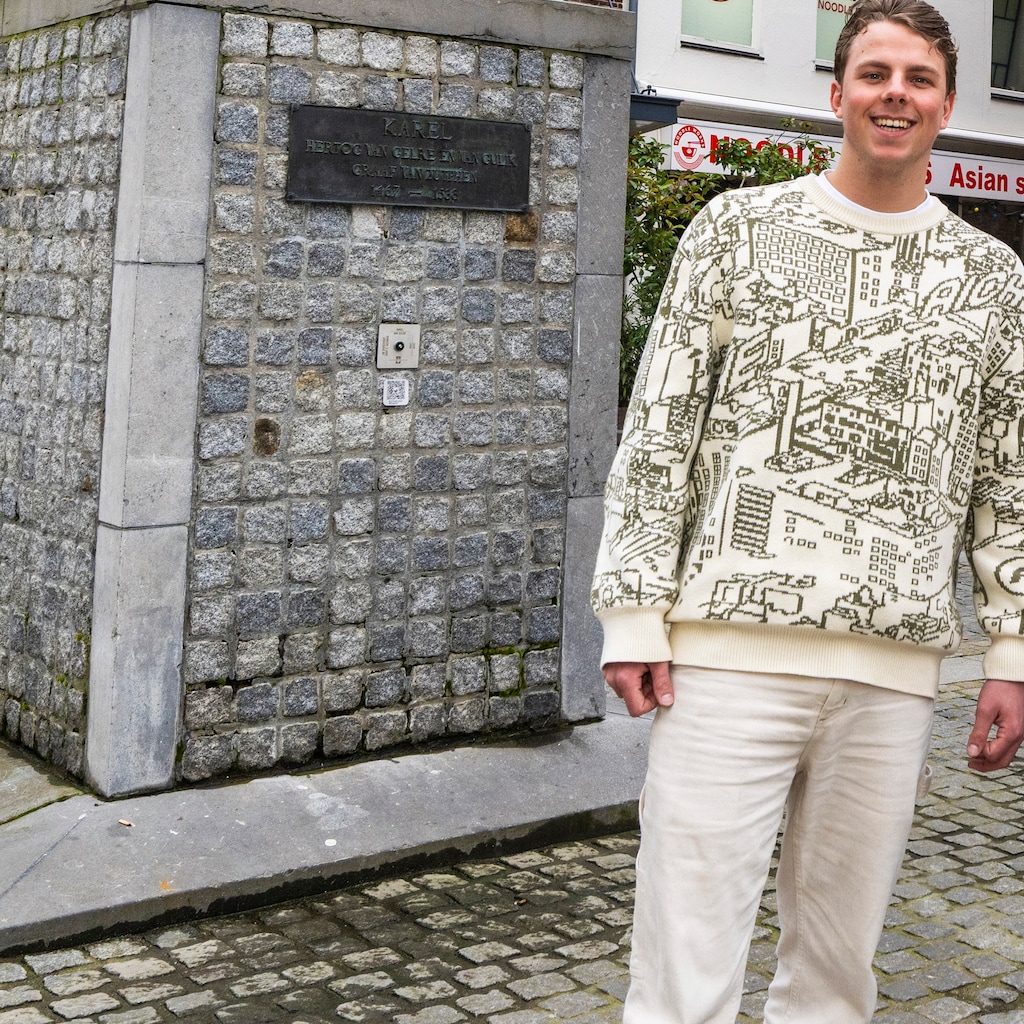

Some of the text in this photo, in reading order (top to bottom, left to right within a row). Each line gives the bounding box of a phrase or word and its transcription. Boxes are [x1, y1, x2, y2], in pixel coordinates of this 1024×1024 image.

[382, 117, 452, 141] KAREL
[305, 139, 517, 167] HERTOG VAN GELRE EN VAN GULIK
[352, 163, 397, 179] GRAAF
[401, 165, 422, 180] VAN
[949, 163, 1008, 193] Asian
